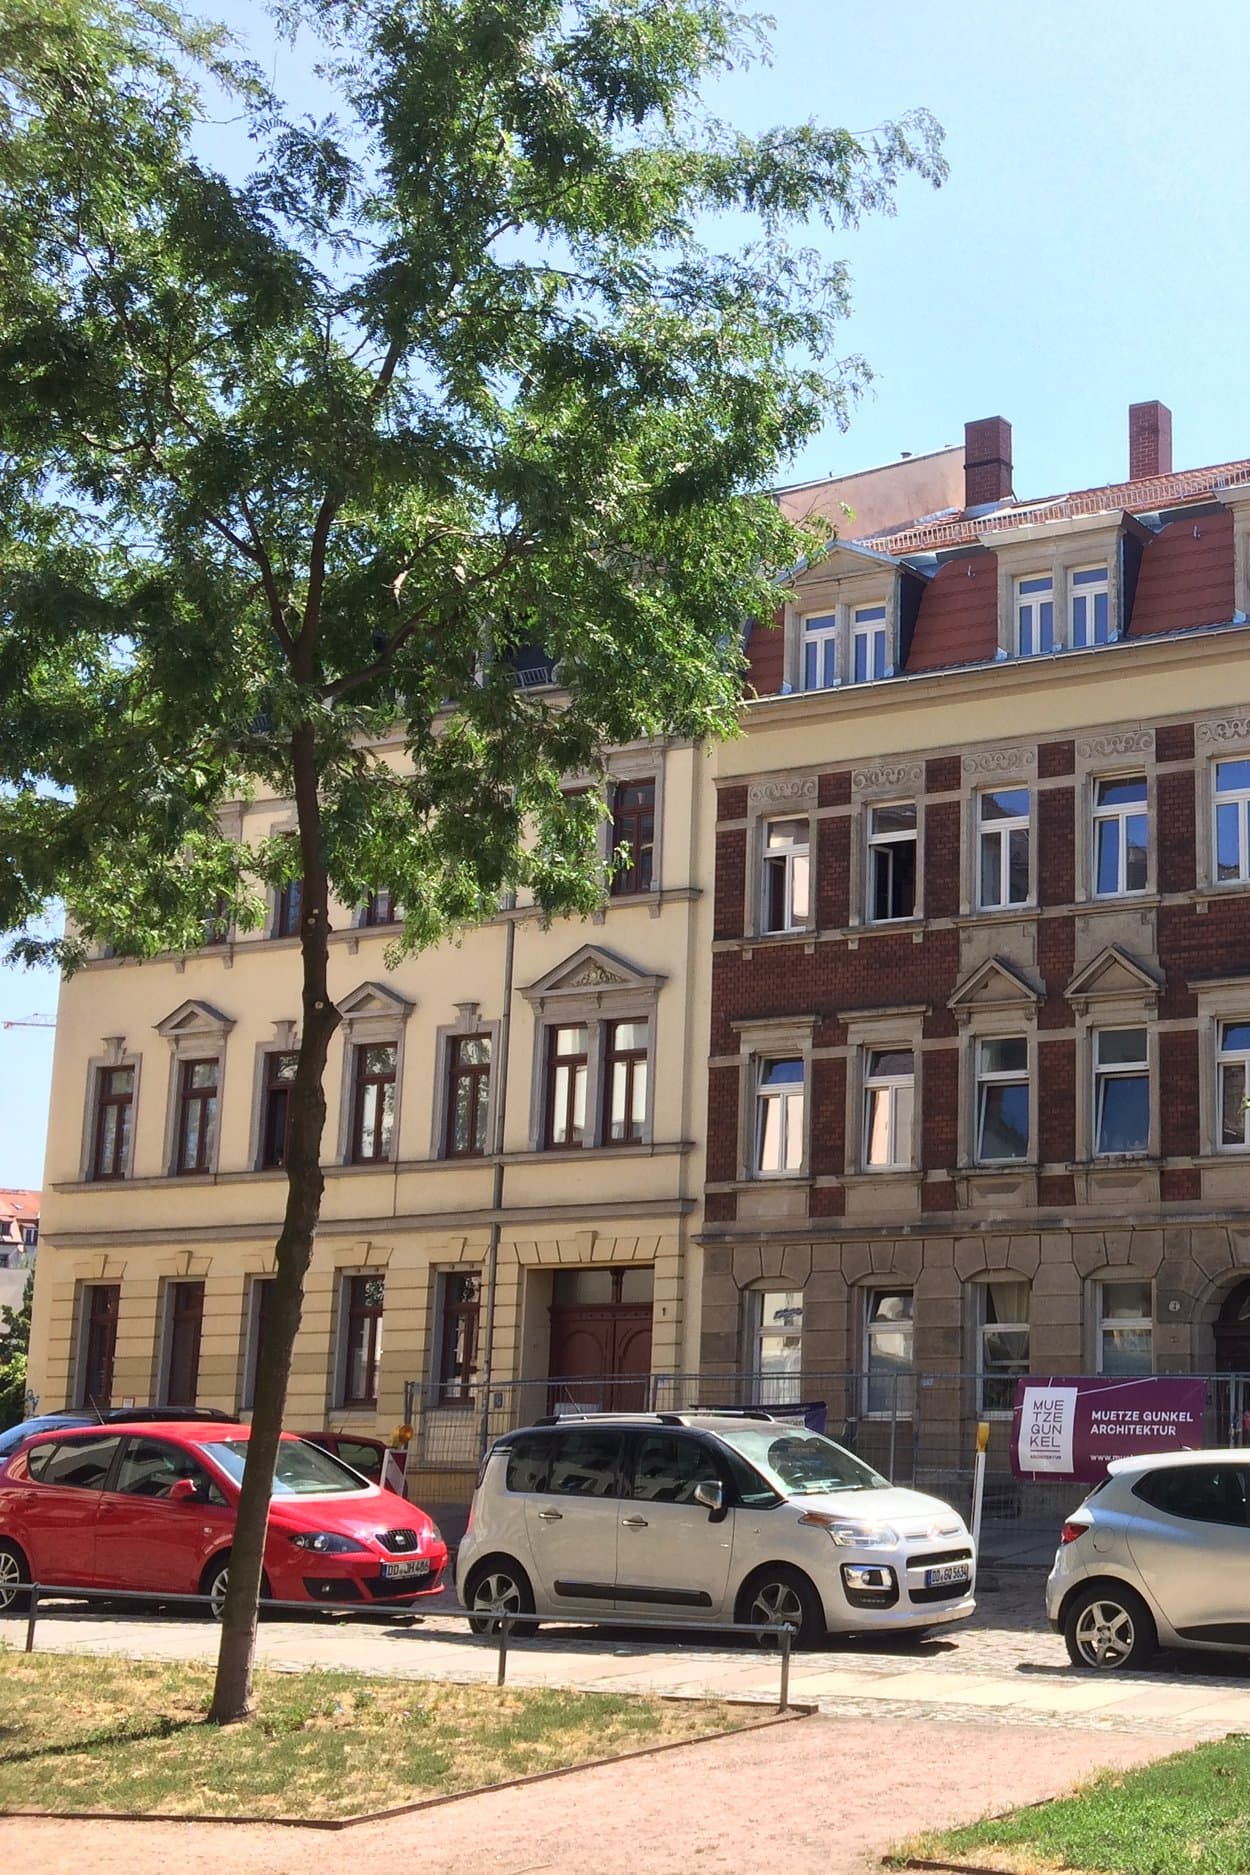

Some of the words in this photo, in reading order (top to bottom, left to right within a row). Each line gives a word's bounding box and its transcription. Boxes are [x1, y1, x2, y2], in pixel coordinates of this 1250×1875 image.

[1033, 1399, 1064, 1411] MUE
[1032, 1411, 1063, 1423] TZE
[1091, 1409, 1140, 1421] MUETZE
[1143, 1410, 1194, 1422] GUNKEL
[1030, 1423, 1062, 1435] GUN
[1090, 1423, 1177, 1436] ARCHITEKTUR
[1029, 1435, 1061, 1448] KEL
